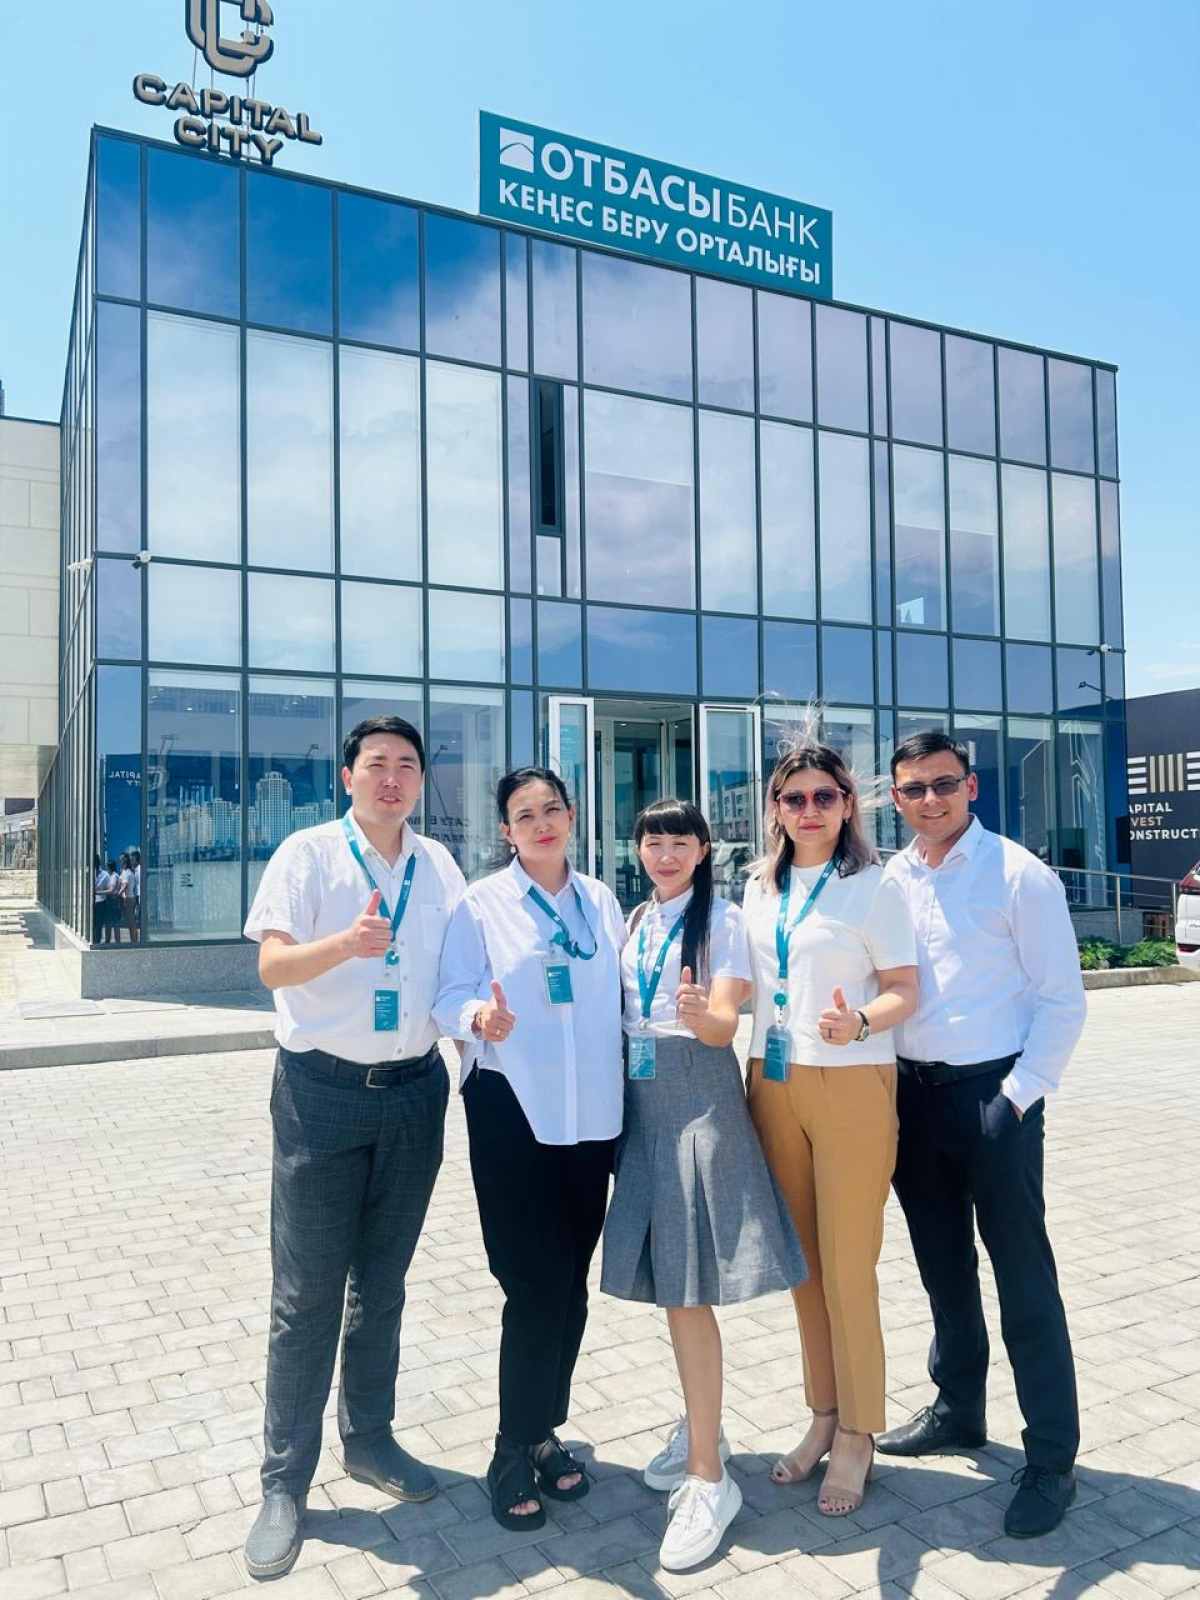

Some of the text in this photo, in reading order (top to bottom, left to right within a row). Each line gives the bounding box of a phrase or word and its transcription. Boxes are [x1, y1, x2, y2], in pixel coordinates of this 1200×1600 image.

[133, 74, 323, 145] CAPITAL
[174, 116, 284, 166] CITY
[500, 179, 821, 285] КЕҢЕС БЕРУ ОРТАЛЫҒЫ
[1129, 802, 1173, 814] PITAL
[1130, 816, 1163, 827] VEST
[1130, 829, 1199, 841] NSTRUCT
